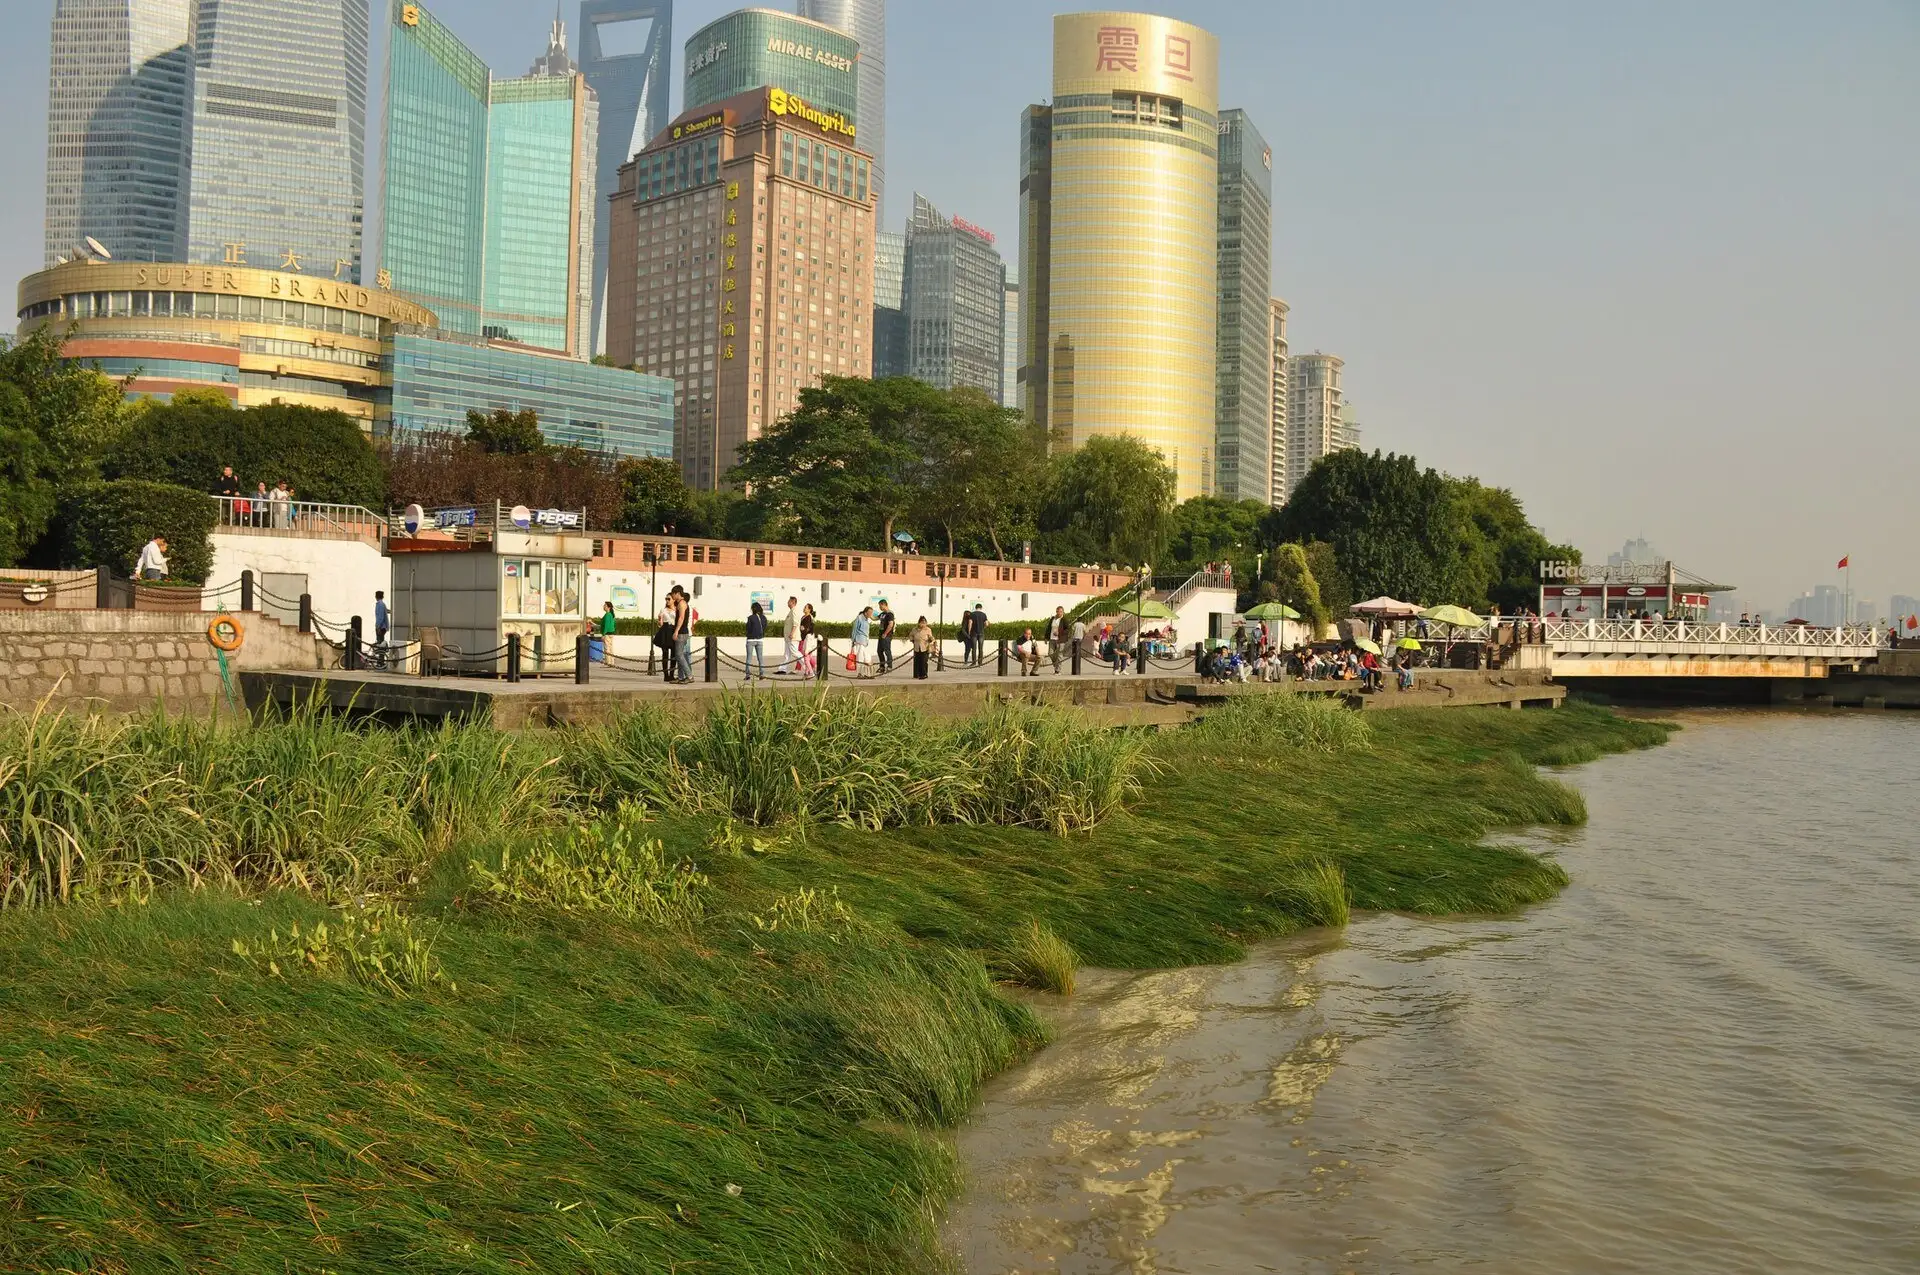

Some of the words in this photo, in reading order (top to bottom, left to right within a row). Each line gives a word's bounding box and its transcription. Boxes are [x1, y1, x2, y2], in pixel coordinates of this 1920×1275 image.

[767, 36, 812, 60] MIRAE
[814, 49, 852, 73] ASSET
[1096, 26, 1193, 82] 震旦
[787, 95, 855, 137] Shangri-La
[222, 242, 392, 290] 正大广场
[137, 266, 238, 290] SUPER
[271, 277, 370, 308] BRAND
[388, 300, 429, 325] MALL
[536, 511, 578, 526] PEPSI
[1540, 560, 1668, 582] Häagen-Dazs
